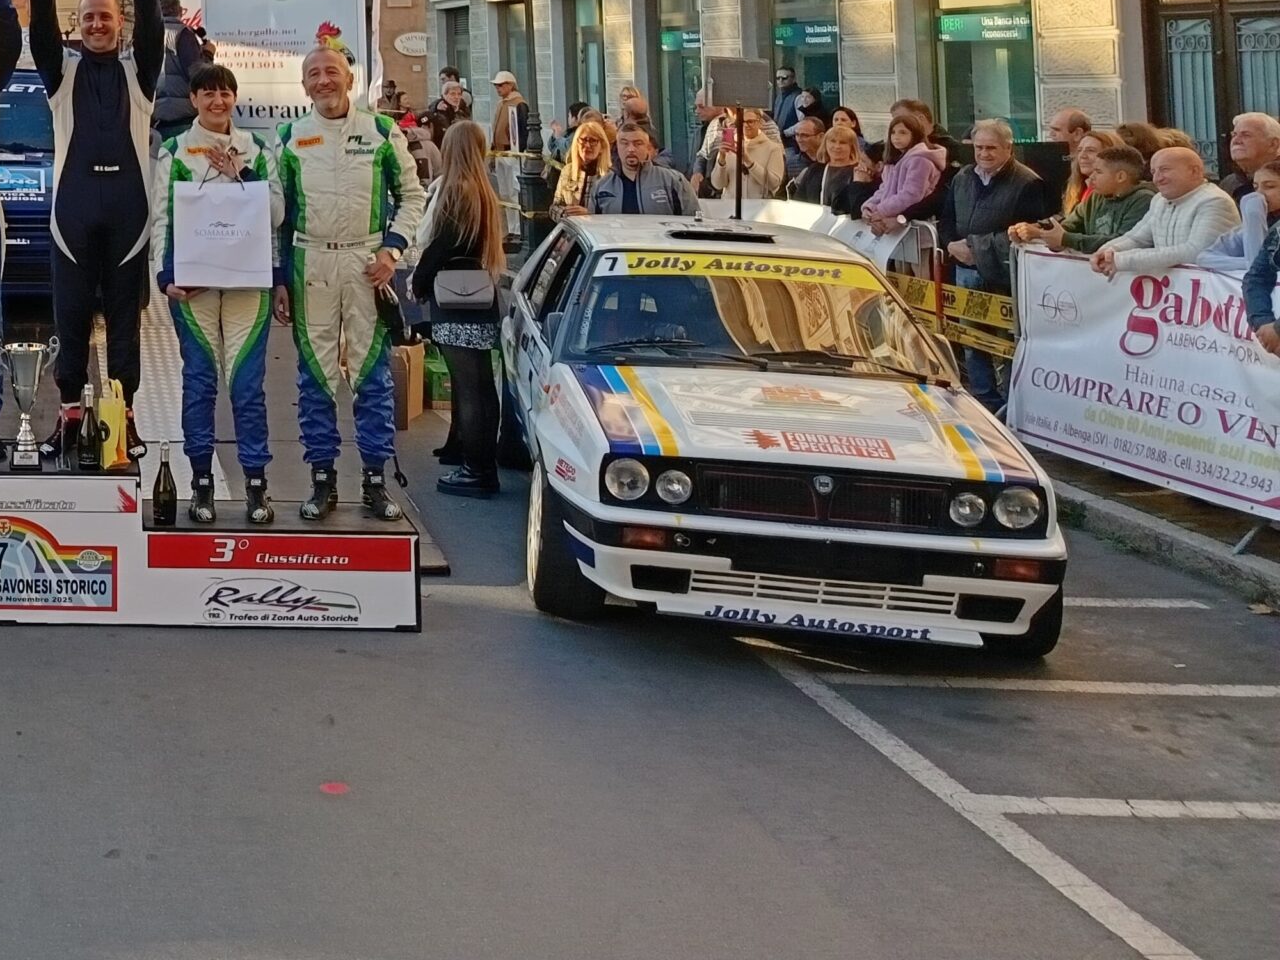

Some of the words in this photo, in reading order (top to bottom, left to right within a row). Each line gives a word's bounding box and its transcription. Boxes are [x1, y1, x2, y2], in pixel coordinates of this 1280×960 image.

[234, 97, 313, 120] vierau
[604, 256, 619, 272] 7
[627, 255, 697, 273] Jolly
[702, 258, 843, 280] Autosport
[1166, 331, 1218, 355] ALBENGA
[1124, 362, 1155, 388] Hai
[1158, 376, 1185, 394] una
[1190, 382, 1237, 406] casa
[1031, 367, 1171, 419] COMPRARE
[1177, 401, 1202, 426] O
[1216, 407, 1280, 449] VEN
[785, 431, 886, 450] FONDAZIONI
[790, 441, 858, 457] SPECIALI
[861, 446, 890, 459] TSG
[1063, 422, 1092, 443] Albenga
[1194, 459, 1273, 493] 334/32.22.943
[255, 552, 350, 565] Classificato
[55, 578, 108, 596] STORICO
[204, 584, 323, 613] Rally
[5, 595, 50, 603] Novembre
[51, 595, 74, 603] 2025
[228, 612, 259, 622] Trofeo
[260, 613, 270, 622] di
[271, 613, 295, 622] Zona
[296, 613, 320, 622] Auto
[321, 613, 360, 623] Storiche
[704, 604, 777, 625] Jolly
[783, 613, 932, 641] Autosport
